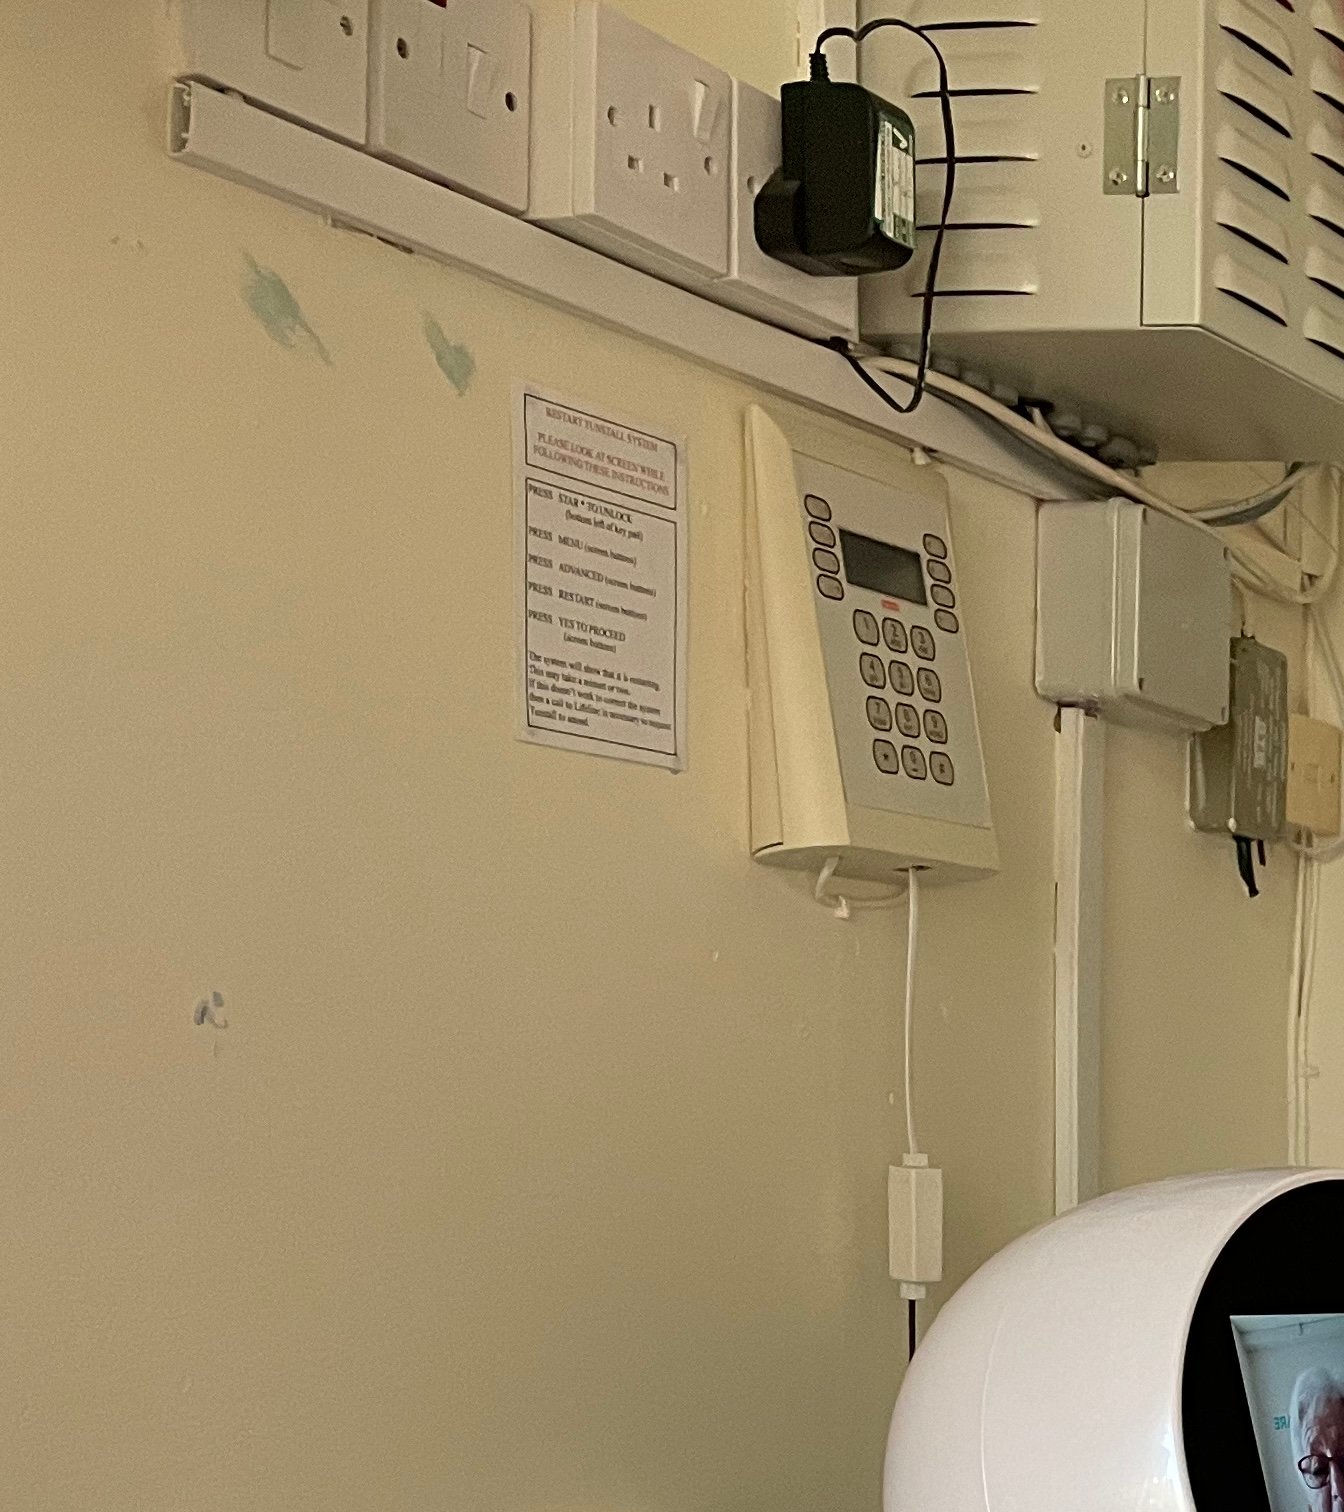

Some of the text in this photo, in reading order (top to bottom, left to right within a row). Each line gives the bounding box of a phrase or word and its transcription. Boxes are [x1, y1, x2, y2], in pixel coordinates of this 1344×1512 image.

[546, 407, 658, 452] RESTART TUNSTALL SYSTEM
[533, 445, 670, 496] FOLLOWING THESE INSTRUCTIONS
[537, 432, 664, 480] PLEASE LOOK AT SCREEN WHILE
[528, 483, 553, 500] PRESS
[558, 493, 578, 507] STAR
[598, 503, 632, 524] UNLOCK
[528, 525, 552, 541] PRESS
[558, 535, 583, 550] MENU
[528, 553, 552, 568] PRESS
[559, 563, 604, 582] ADVANCED
[528, 581, 552, 596] PRESS
[559, 589, 594, 608] RESTART
[528, 609, 626, 642] PRESS YES TO PROCEED
